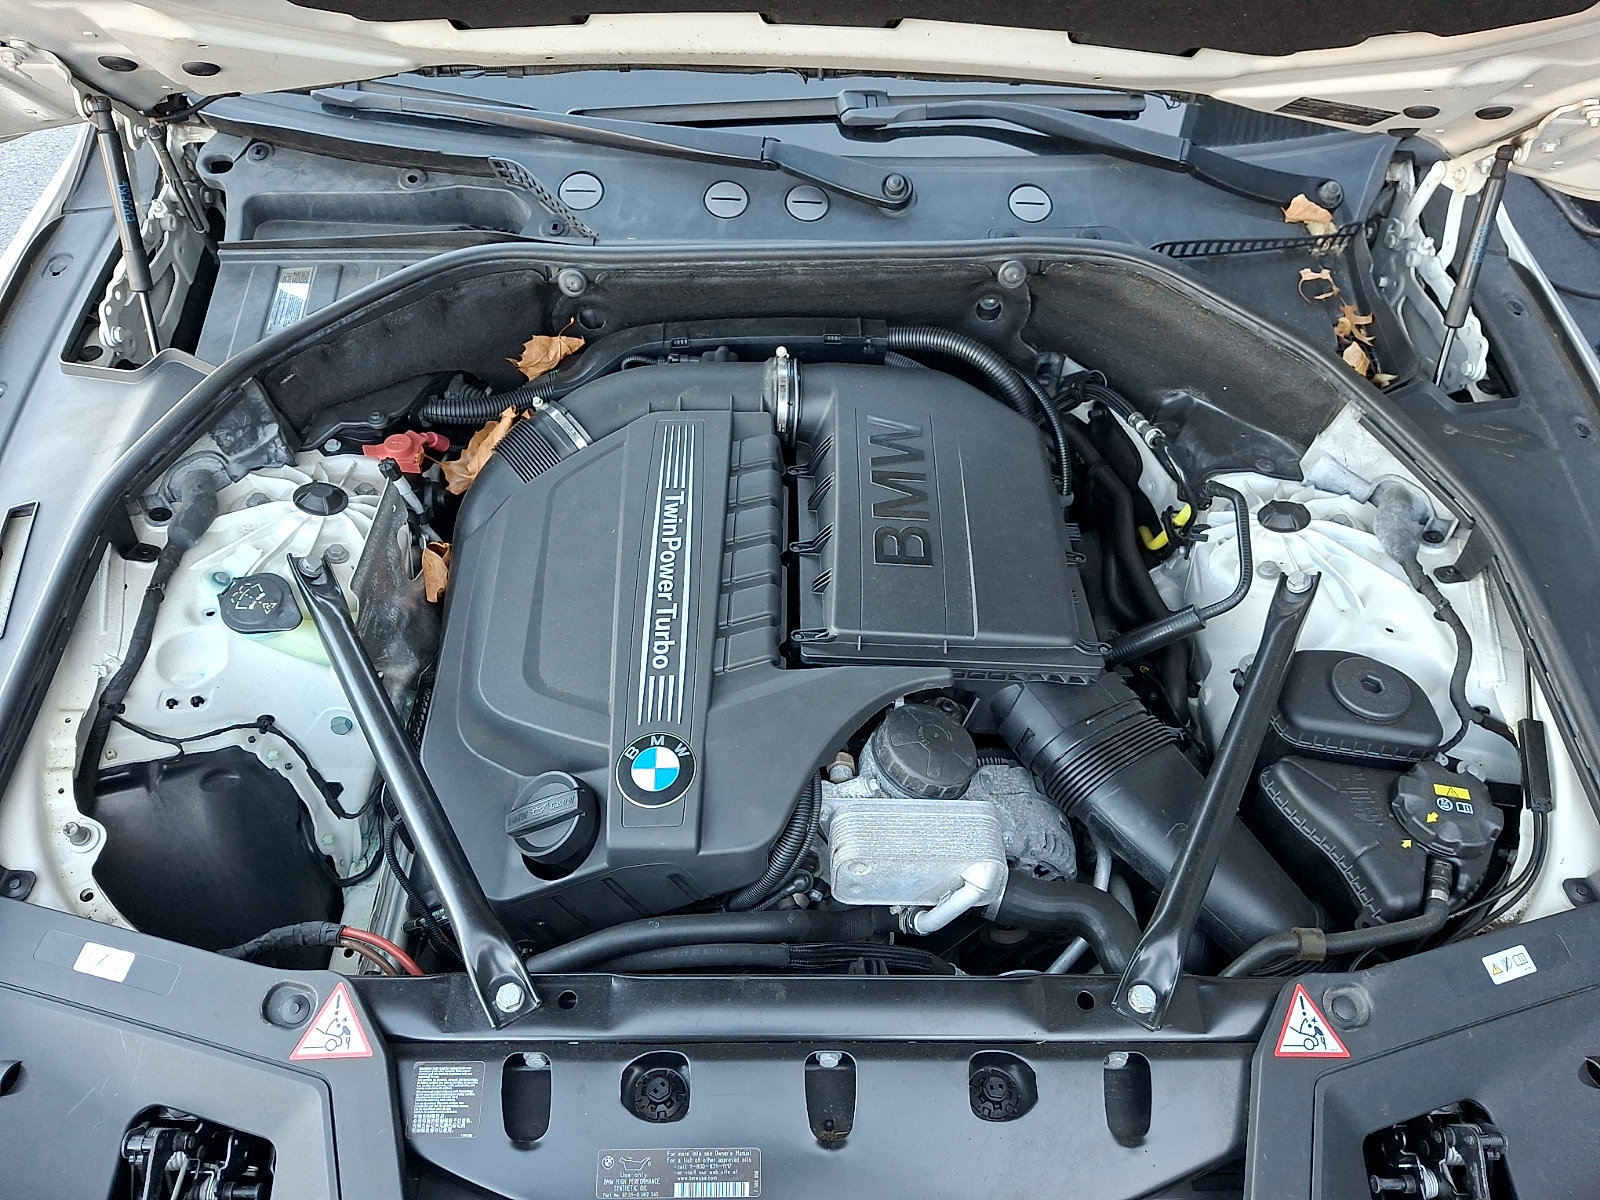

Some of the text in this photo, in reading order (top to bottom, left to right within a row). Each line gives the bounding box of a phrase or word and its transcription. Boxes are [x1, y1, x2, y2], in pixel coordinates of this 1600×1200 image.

[867, 415, 933, 568] BMW
[652, 491, 686, 670] TwinPower Turbo
[624, 735, 691, 761] BMW
